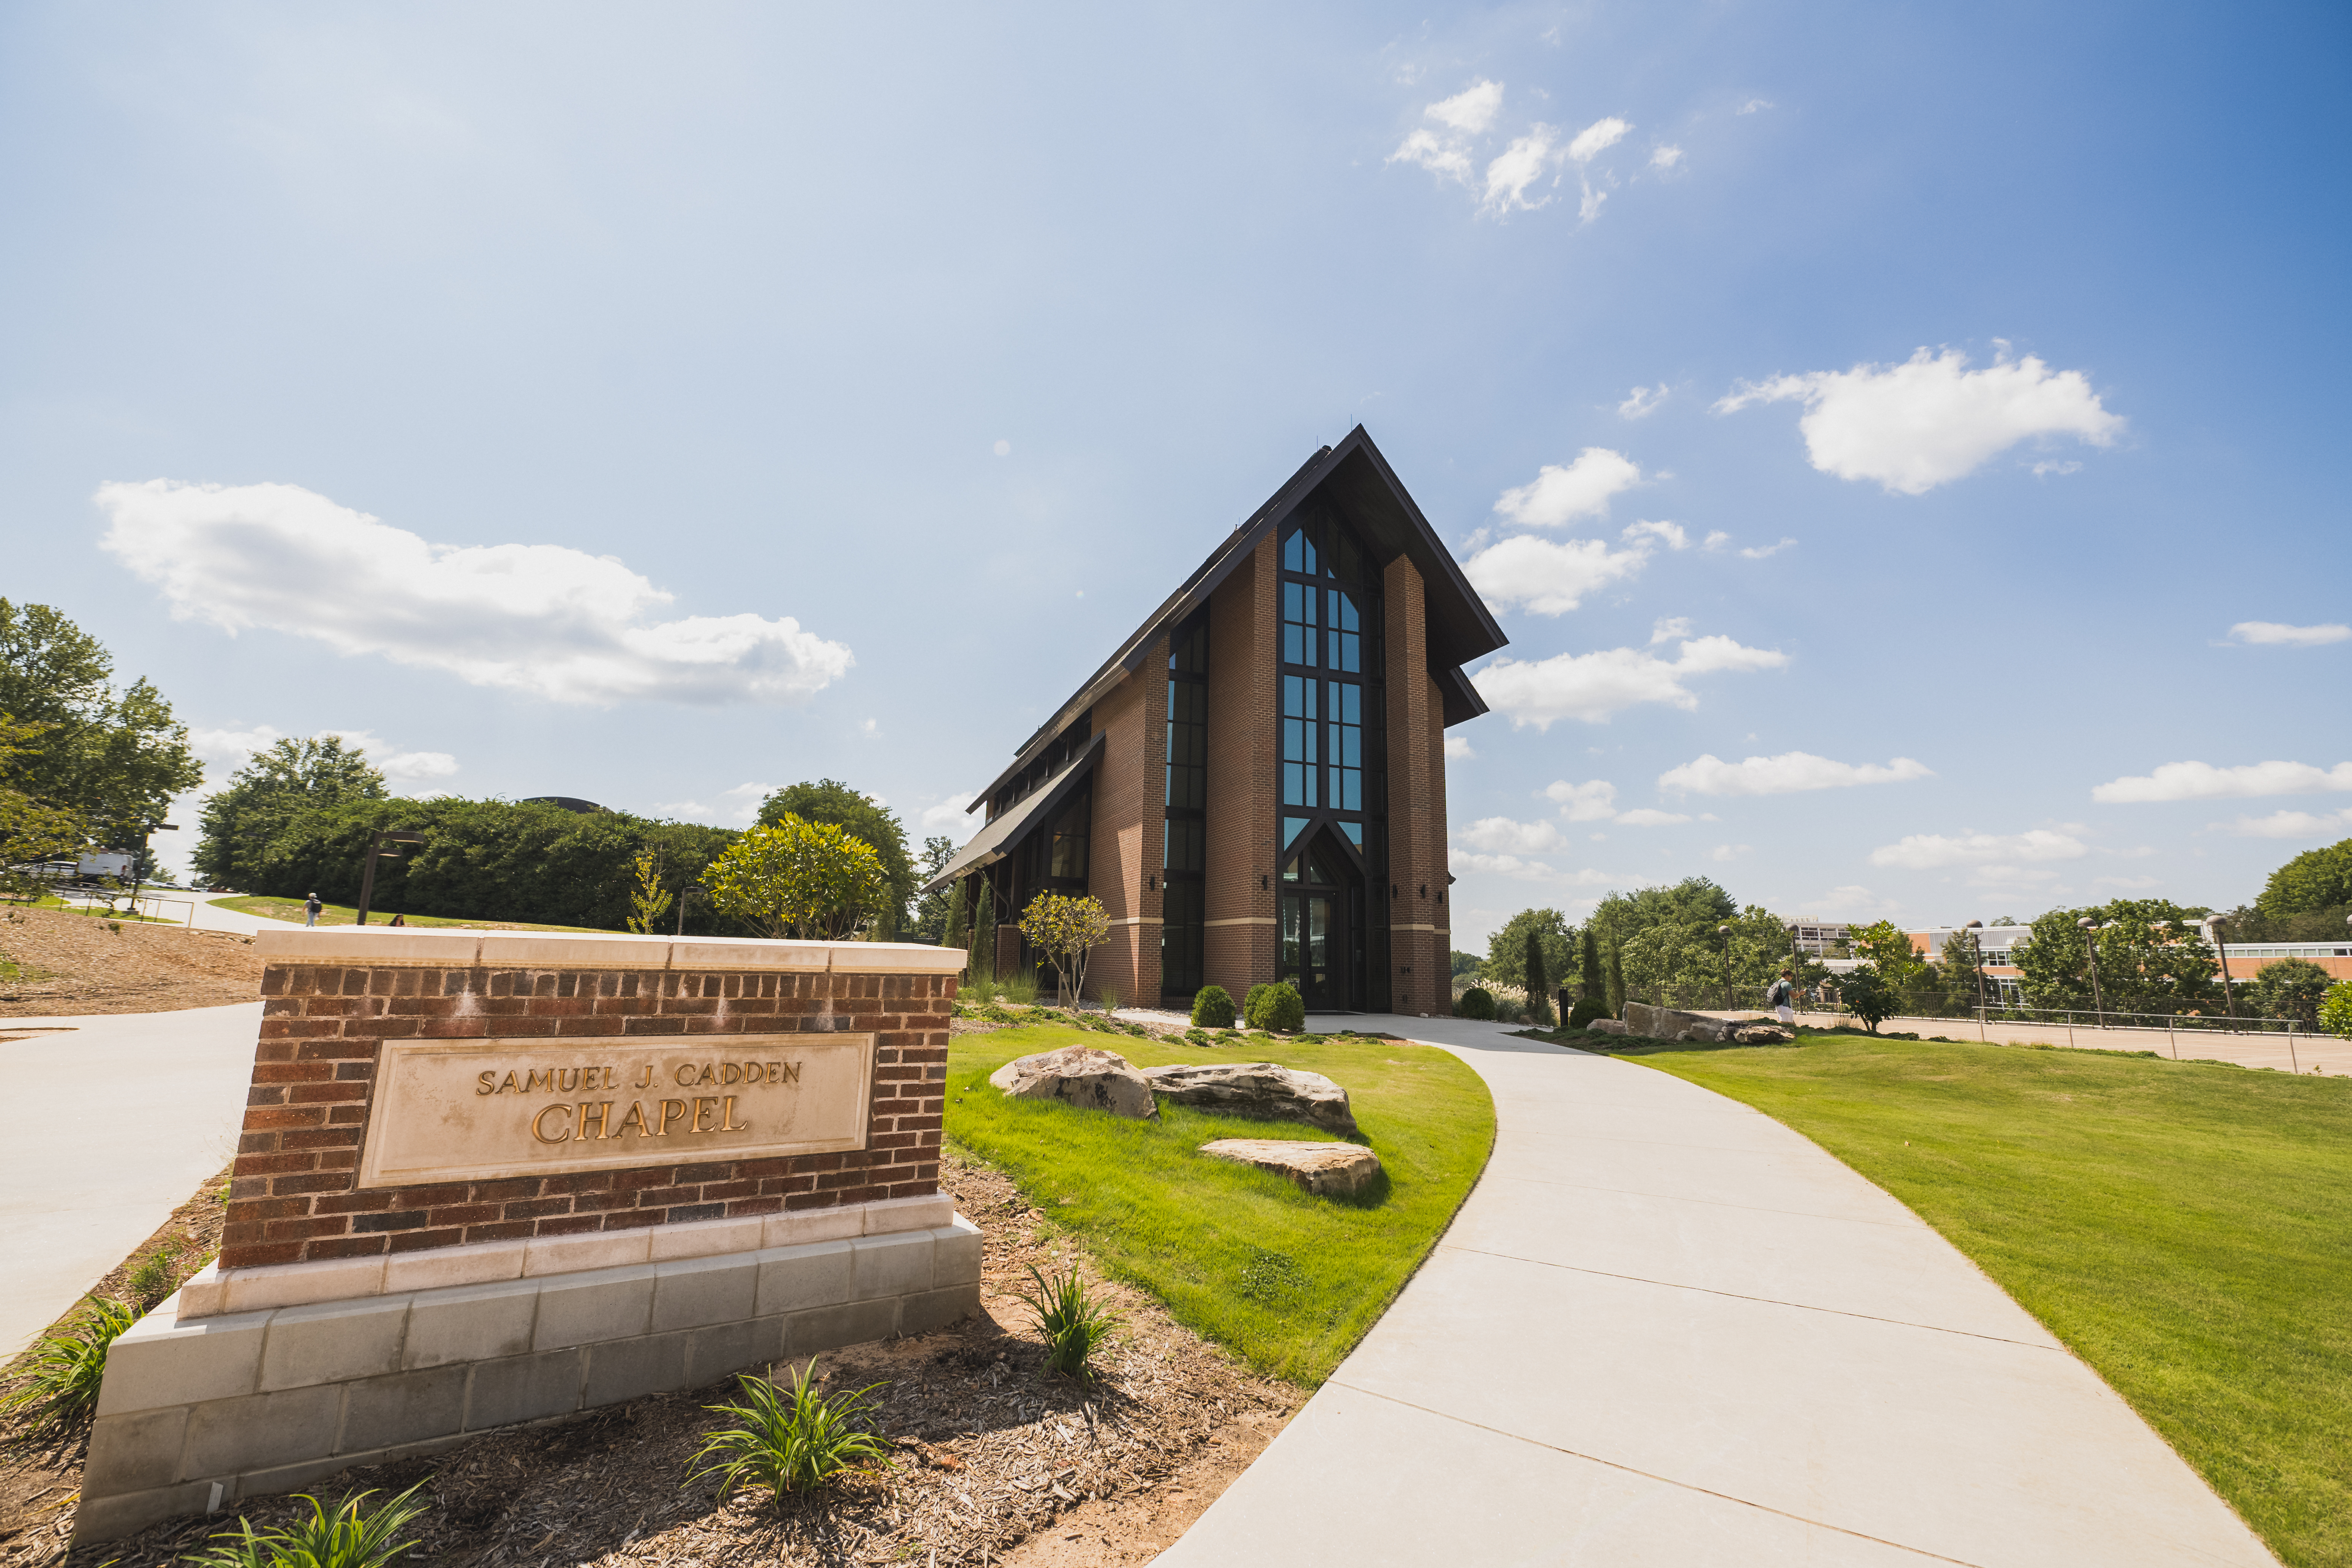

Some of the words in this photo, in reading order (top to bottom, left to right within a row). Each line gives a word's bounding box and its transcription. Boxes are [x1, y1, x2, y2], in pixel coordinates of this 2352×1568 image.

[476, 1066, 620, 1095] SAMUEL
[635, 1065, 659, 1089] J.
[675, 1062, 802, 1086] CADDEN
[532, 1095, 748, 1144] CHAPEL
